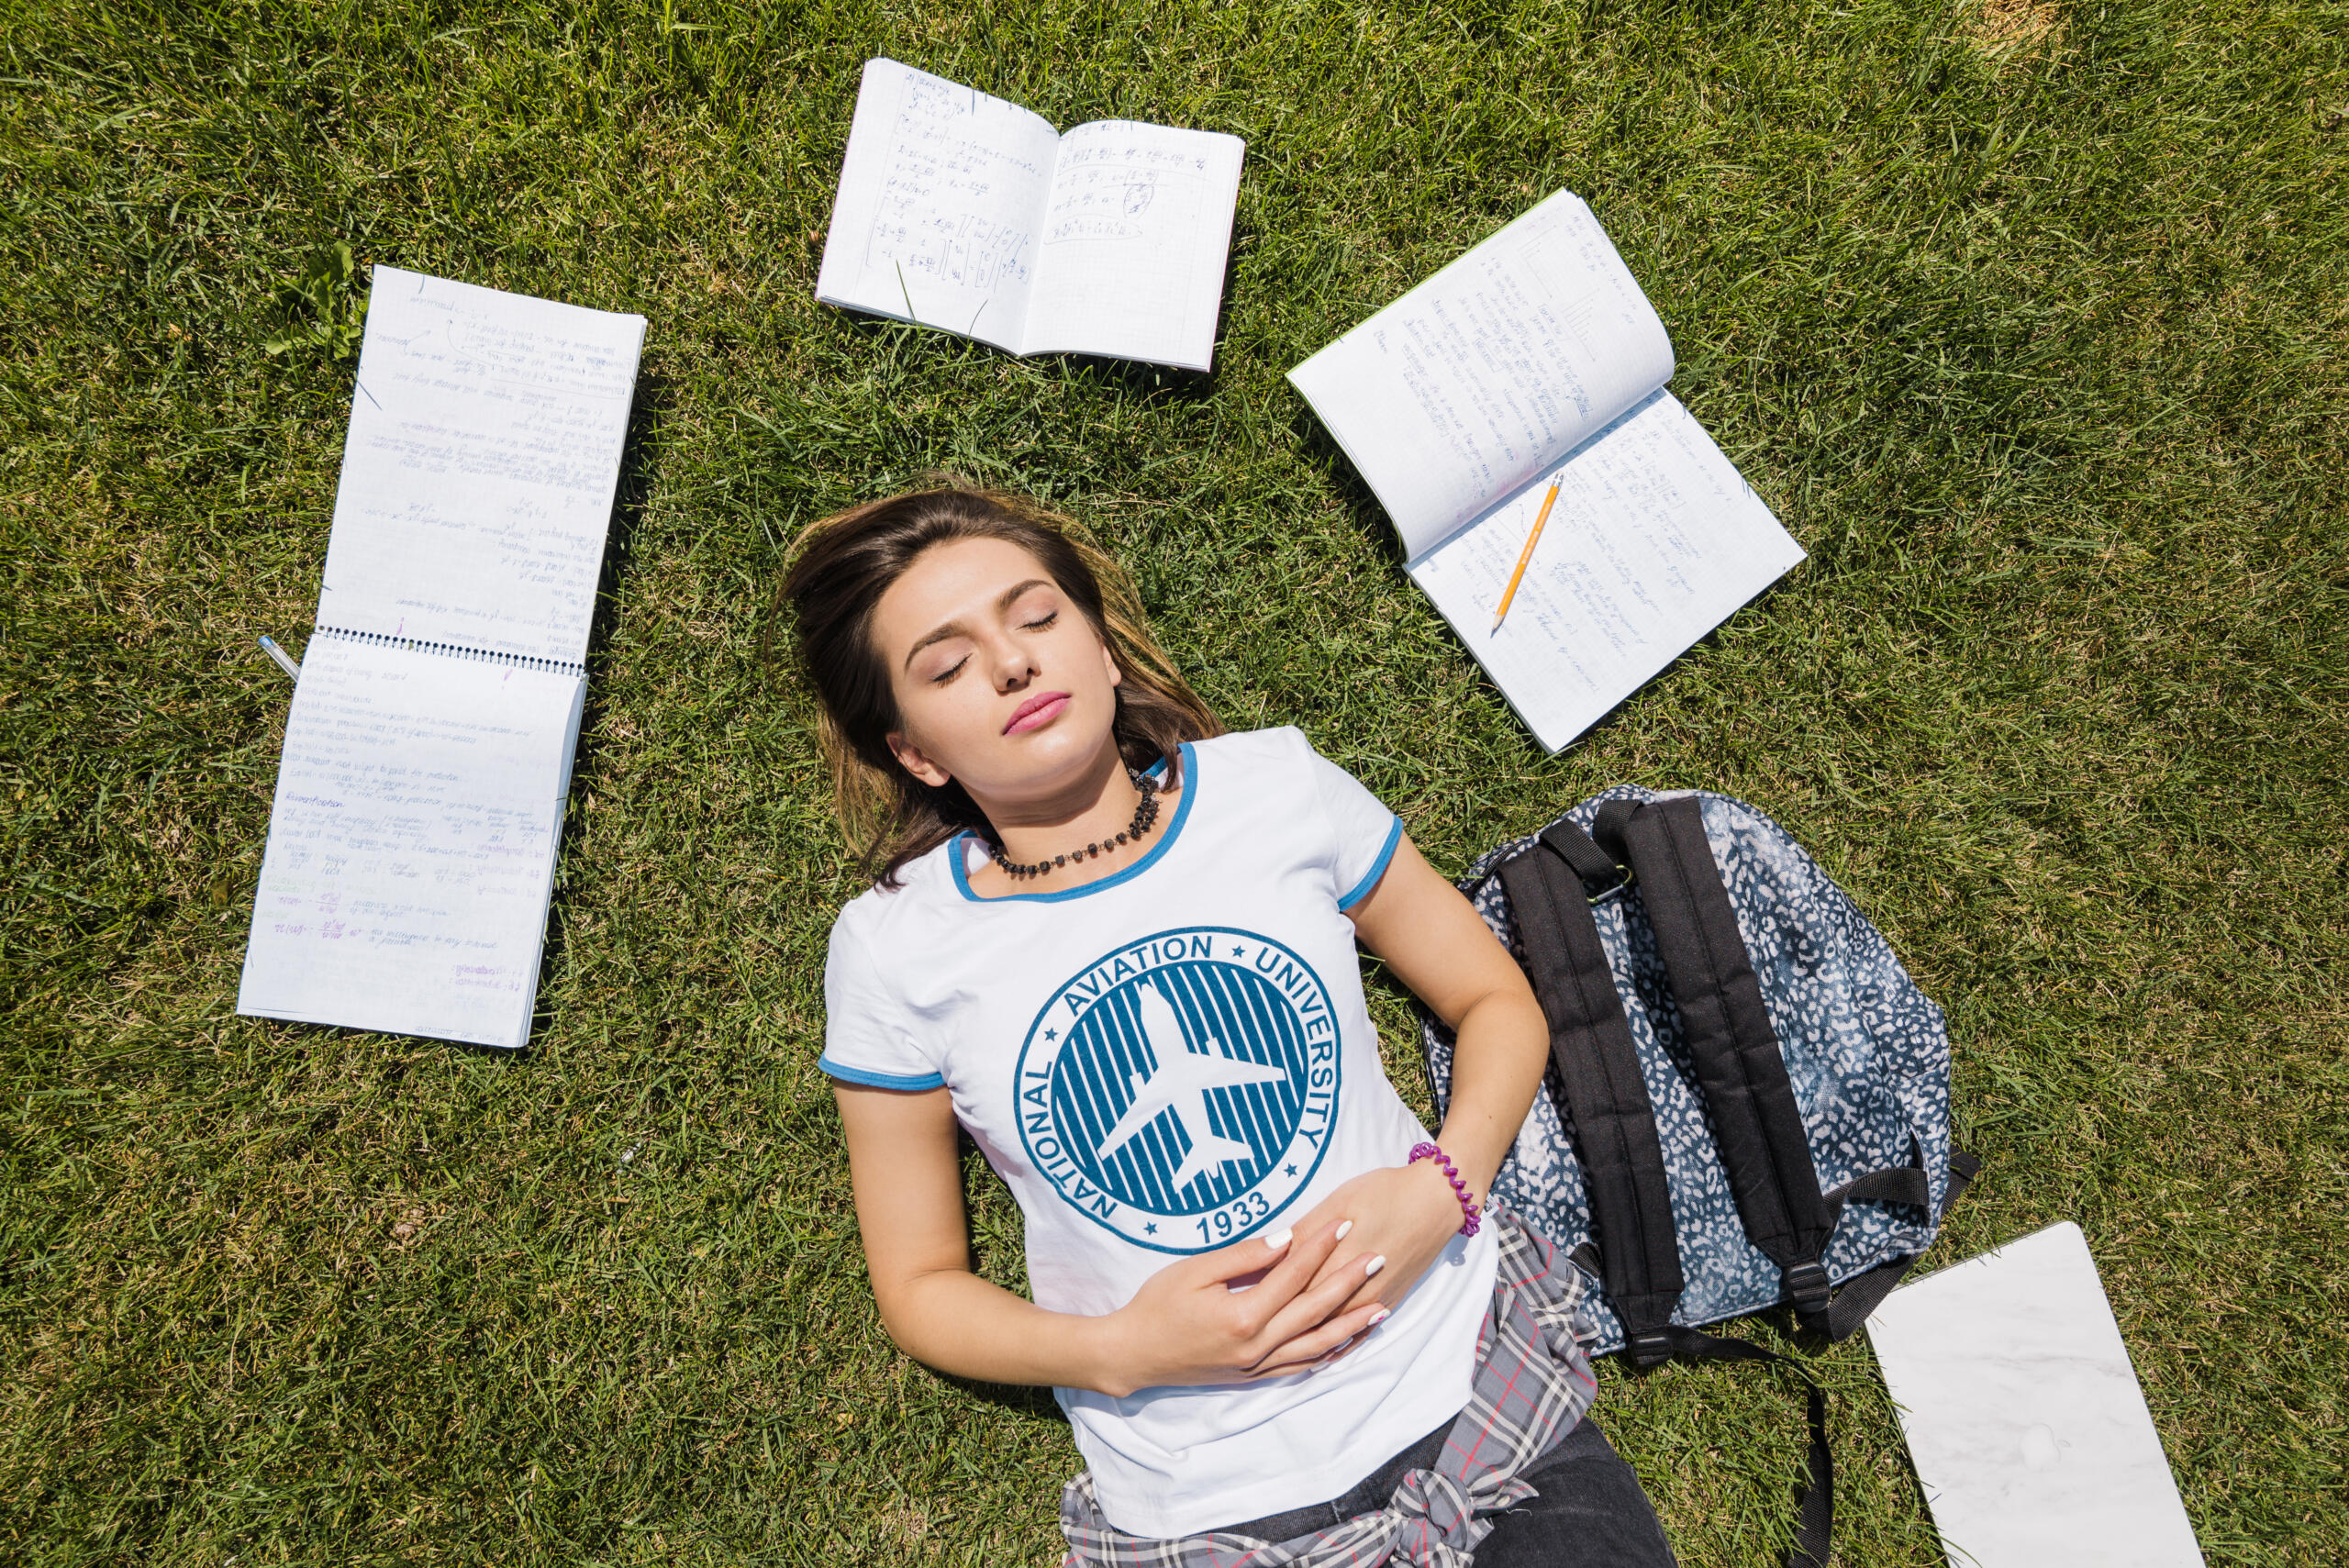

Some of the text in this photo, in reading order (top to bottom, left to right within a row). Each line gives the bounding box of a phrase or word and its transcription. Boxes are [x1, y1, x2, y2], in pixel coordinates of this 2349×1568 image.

[1023, 935, 1333, 1219] NATIONAL AVIATION UNIVERSITY
[1196, 1191, 1271, 1245] 1933
